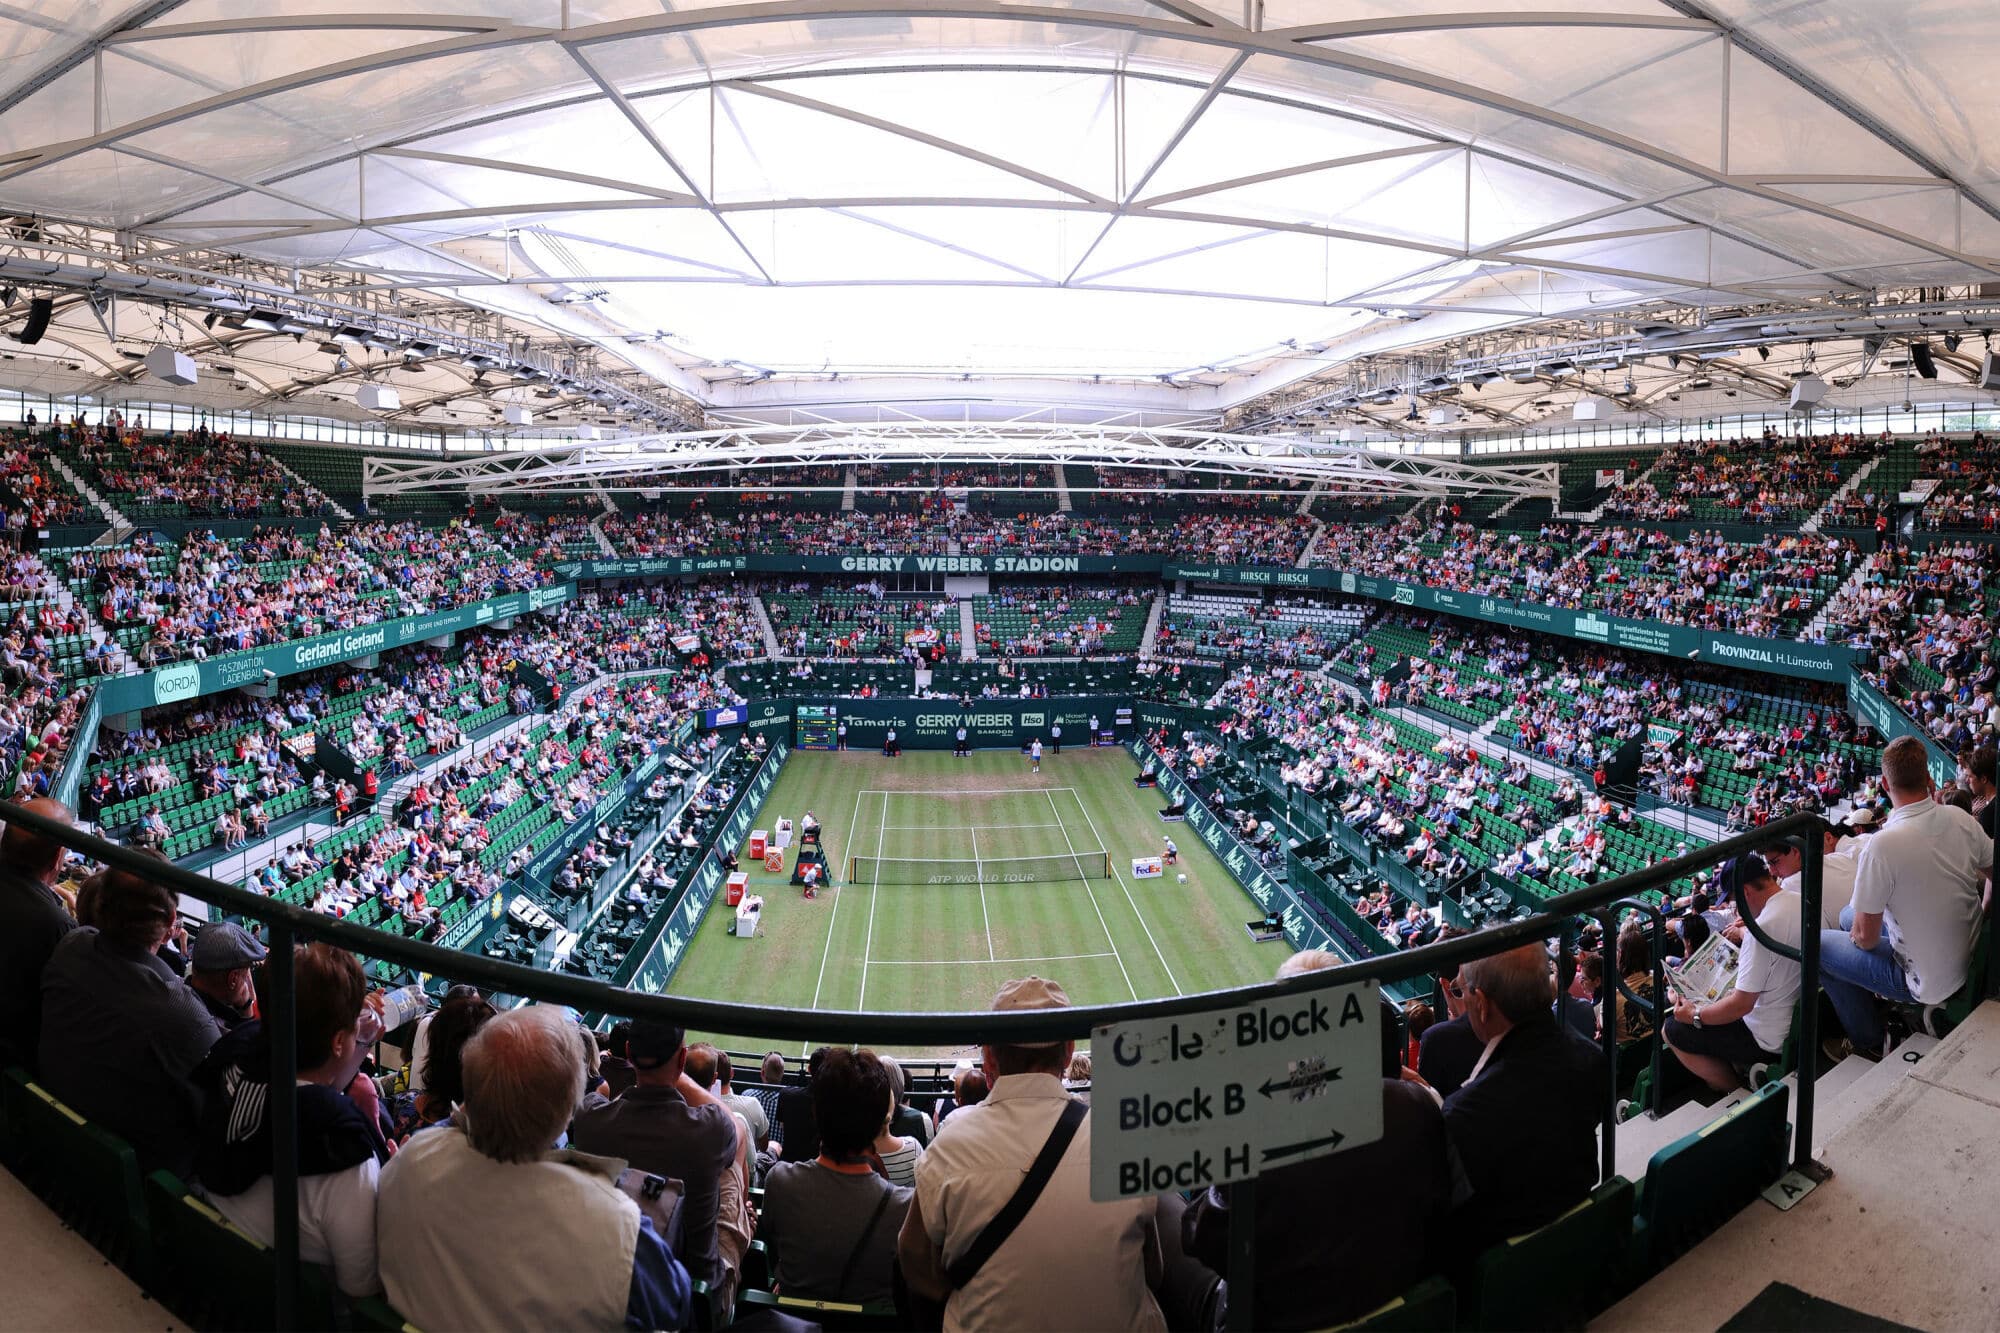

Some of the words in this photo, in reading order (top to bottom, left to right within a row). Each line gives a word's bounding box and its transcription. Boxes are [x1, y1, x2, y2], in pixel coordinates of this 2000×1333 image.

[698, 561, 718, 570] radio
[720, 558, 732, 568] ffn
[841, 557, 905, 571] GERRY
[917, 557, 983, 571] WEBER
[994, 557, 1079, 571] STADION
[1178, 569, 1210, 577] Piepenbrock
[1240, 571, 1270, 581] HIRSCH
[1278, 572, 1309, 583] HIRSCH
[1480, 600, 1495, 611] JAB
[1497, 606, 1514, 615] STOFFE
[1514, 609, 1526, 617] UND
[1527, 610, 1551, 622] TEPPICHE
[400, 621, 415, 634] JAB
[1655, 630, 1670, 639] Bauen
[295, 638, 341, 664] Gerland
[343, 628, 385, 652] Gerland
[218, 656, 265, 674] FASZINATION
[222, 668, 261, 686] LADENBAU
[159, 676, 198, 694] KORDA
[749, 719, 771, 730] GERRY
[772, 715, 791, 728] WEBER
[843, 715, 907, 731] Tamaris
[915, 714, 962, 728] GERRY
[964, 714, 1014, 728] WEBER
[1065, 712, 1088, 720] Microsoft
[1065, 718, 1088, 726] Dynamics
[1141, 714, 1176, 728] TAIFUN
[1136, 864, 1161, 875] FedEx
[928, 875, 952, 884] ATP
[1004, 873, 1036, 882] TOUR
[1236, 998, 1330, 1047] Block
[1340, 993, 1364, 1028] A
[1120, 1087, 1212, 1131] Block
[1224, 1083, 1245, 1115] B
[1120, 1150, 1212, 1194] Block
[1225, 1143, 1249, 1178] H
[1780, 1180, 1802, 1199] A
